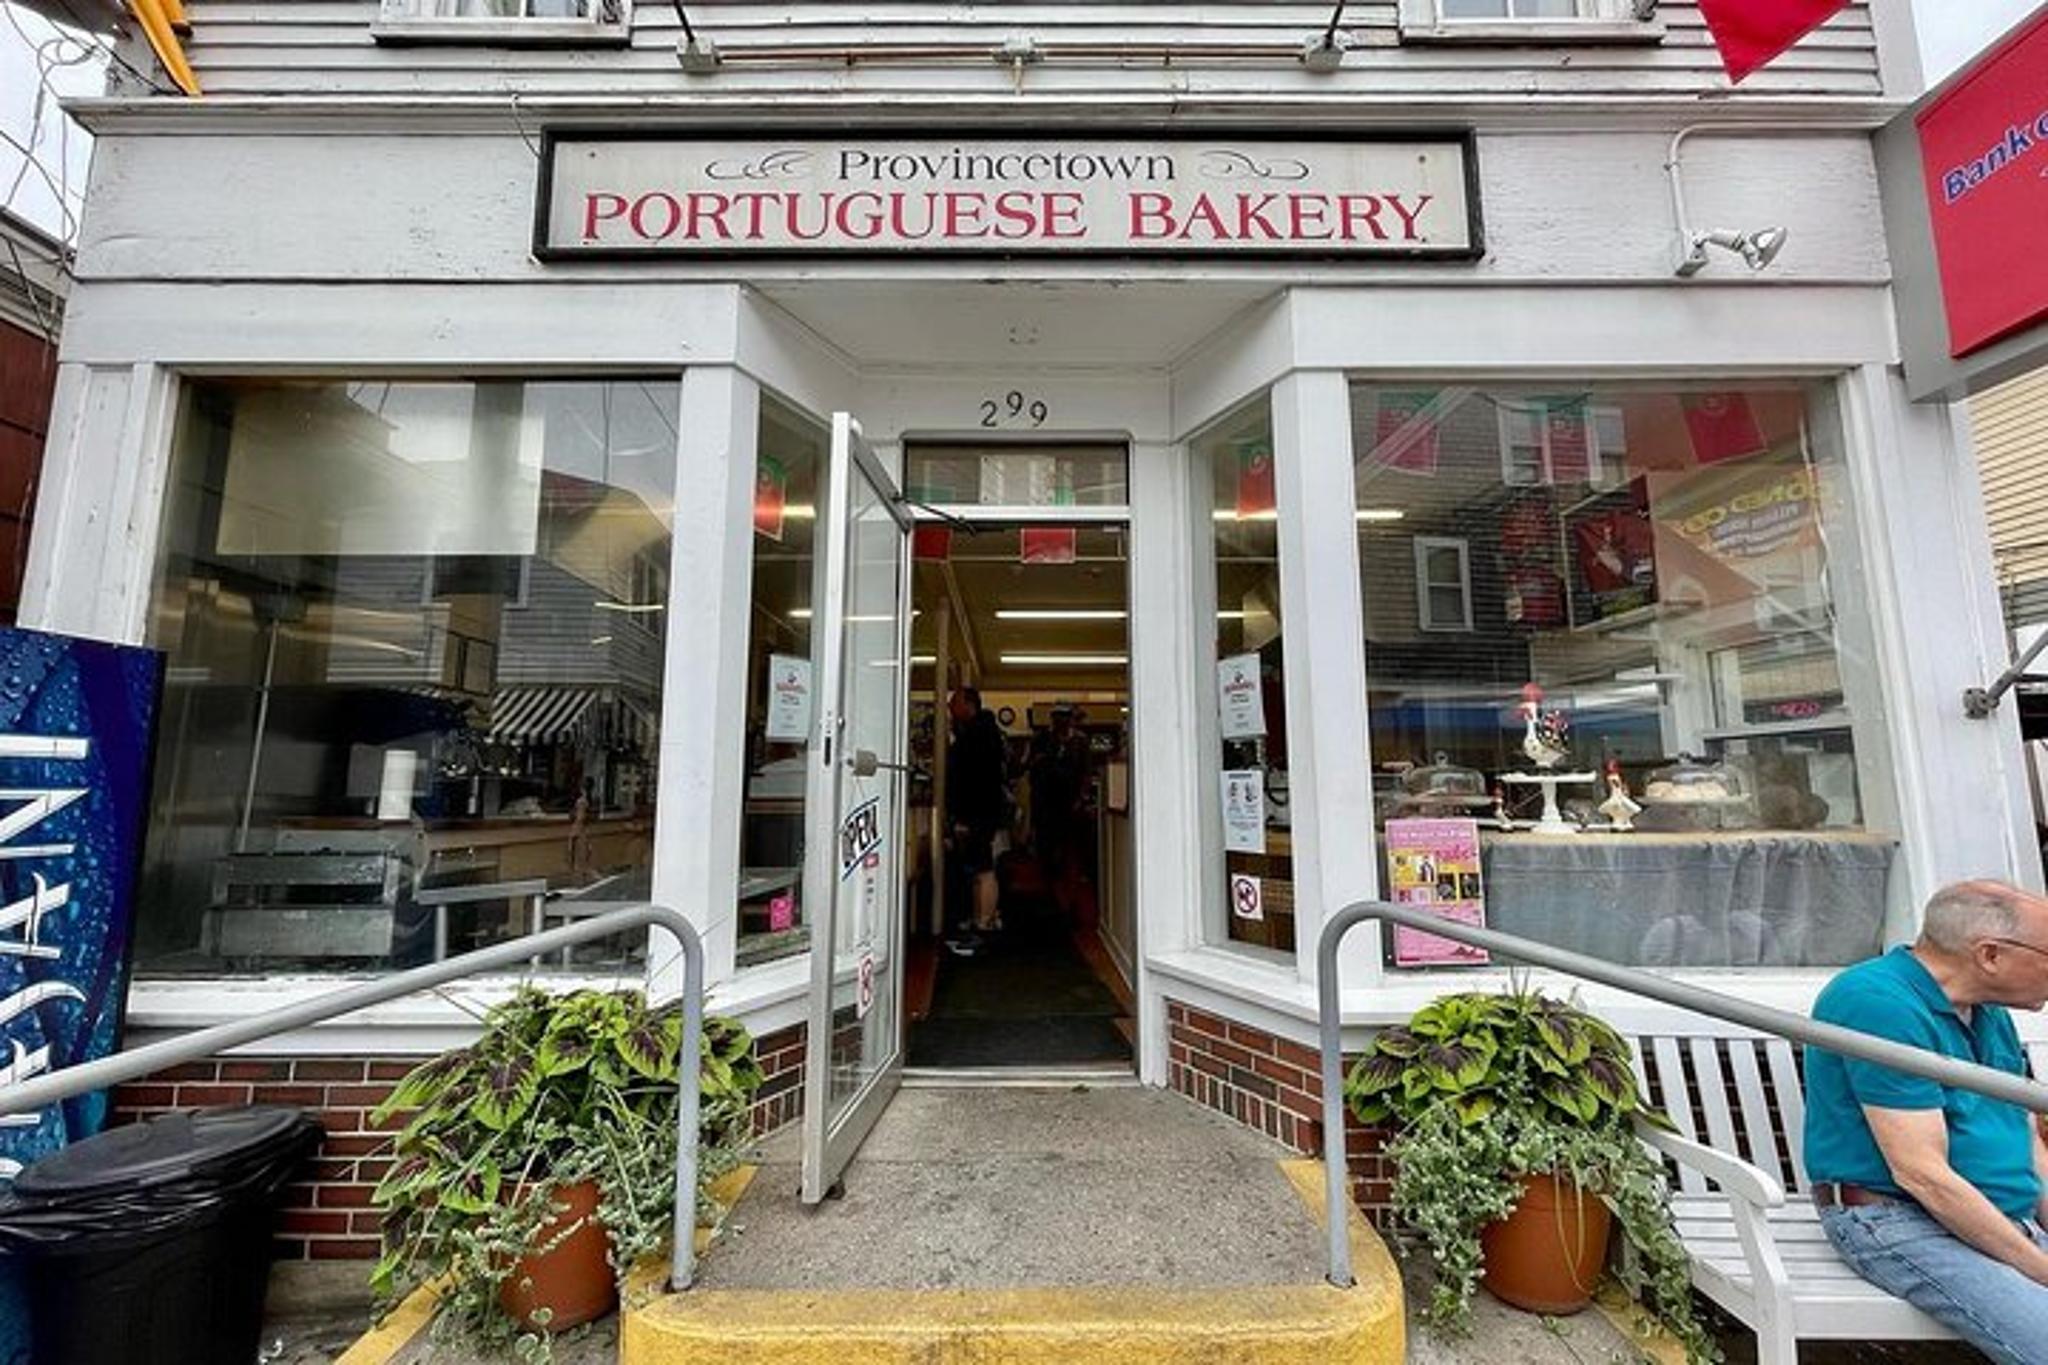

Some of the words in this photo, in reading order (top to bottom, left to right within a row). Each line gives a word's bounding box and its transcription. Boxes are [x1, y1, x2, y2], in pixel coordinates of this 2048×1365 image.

[838, 147, 1175, 181] Provincetown
[1943, 122, 2034, 204] Bank
[582, 192, 1087, 241] PORTUGUESE
[1128, 193, 1434, 241] BAKERY
[980, 391, 1048, 427] 299
